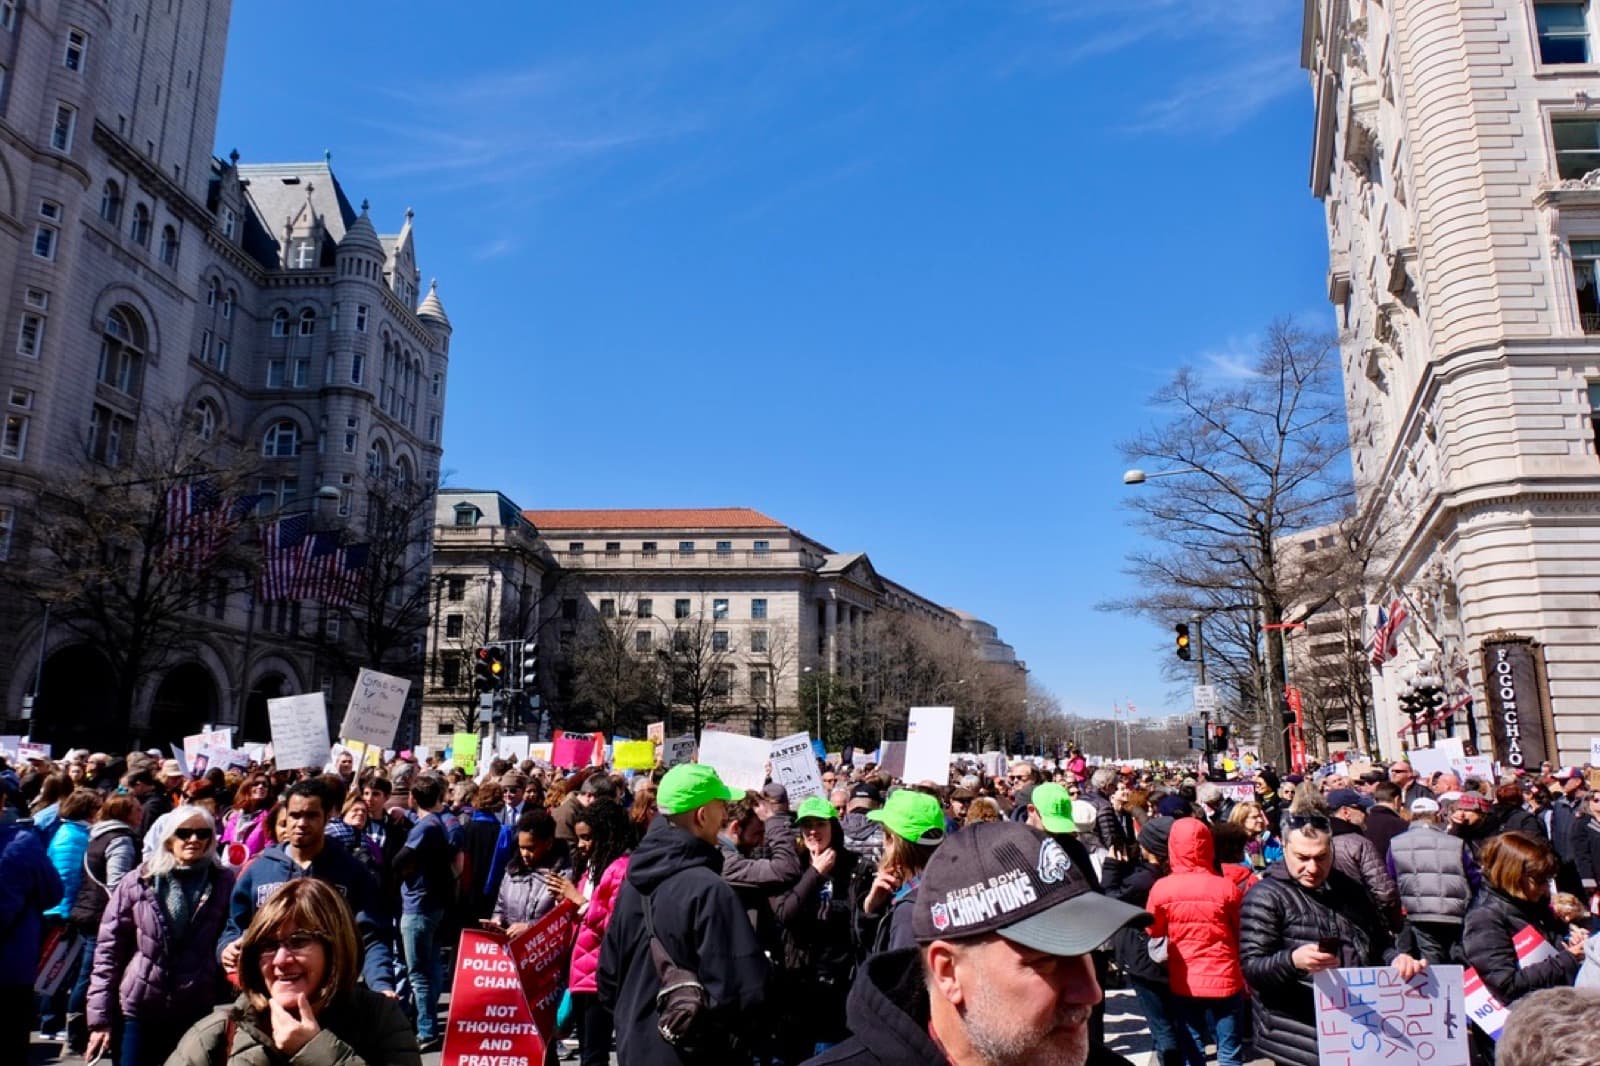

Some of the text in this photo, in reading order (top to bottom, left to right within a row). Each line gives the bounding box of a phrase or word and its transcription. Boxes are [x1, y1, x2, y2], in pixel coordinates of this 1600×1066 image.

[1497, 649, 1514, 700] FOGO
[946, 868, 1026, 903] SUPER BOWL
[947, 875, 1038, 927] CHAMPIONS
[475, 942, 499, 955] WE
[520, 933, 565, 970] POLICY
[524, 931, 546, 952] WE
[462, 958, 516, 973] POLICY
[485, 1004, 518, 1018] NOT
[1346, 969, 1382, 1053] SAFE
[1377, 968, 1409, 1059] YOUR
[457, 1020, 540, 1036] THOUGHTS
[479, 1037, 513, 1051] AND
[458, 1054, 530, 1066] PRAYERS
